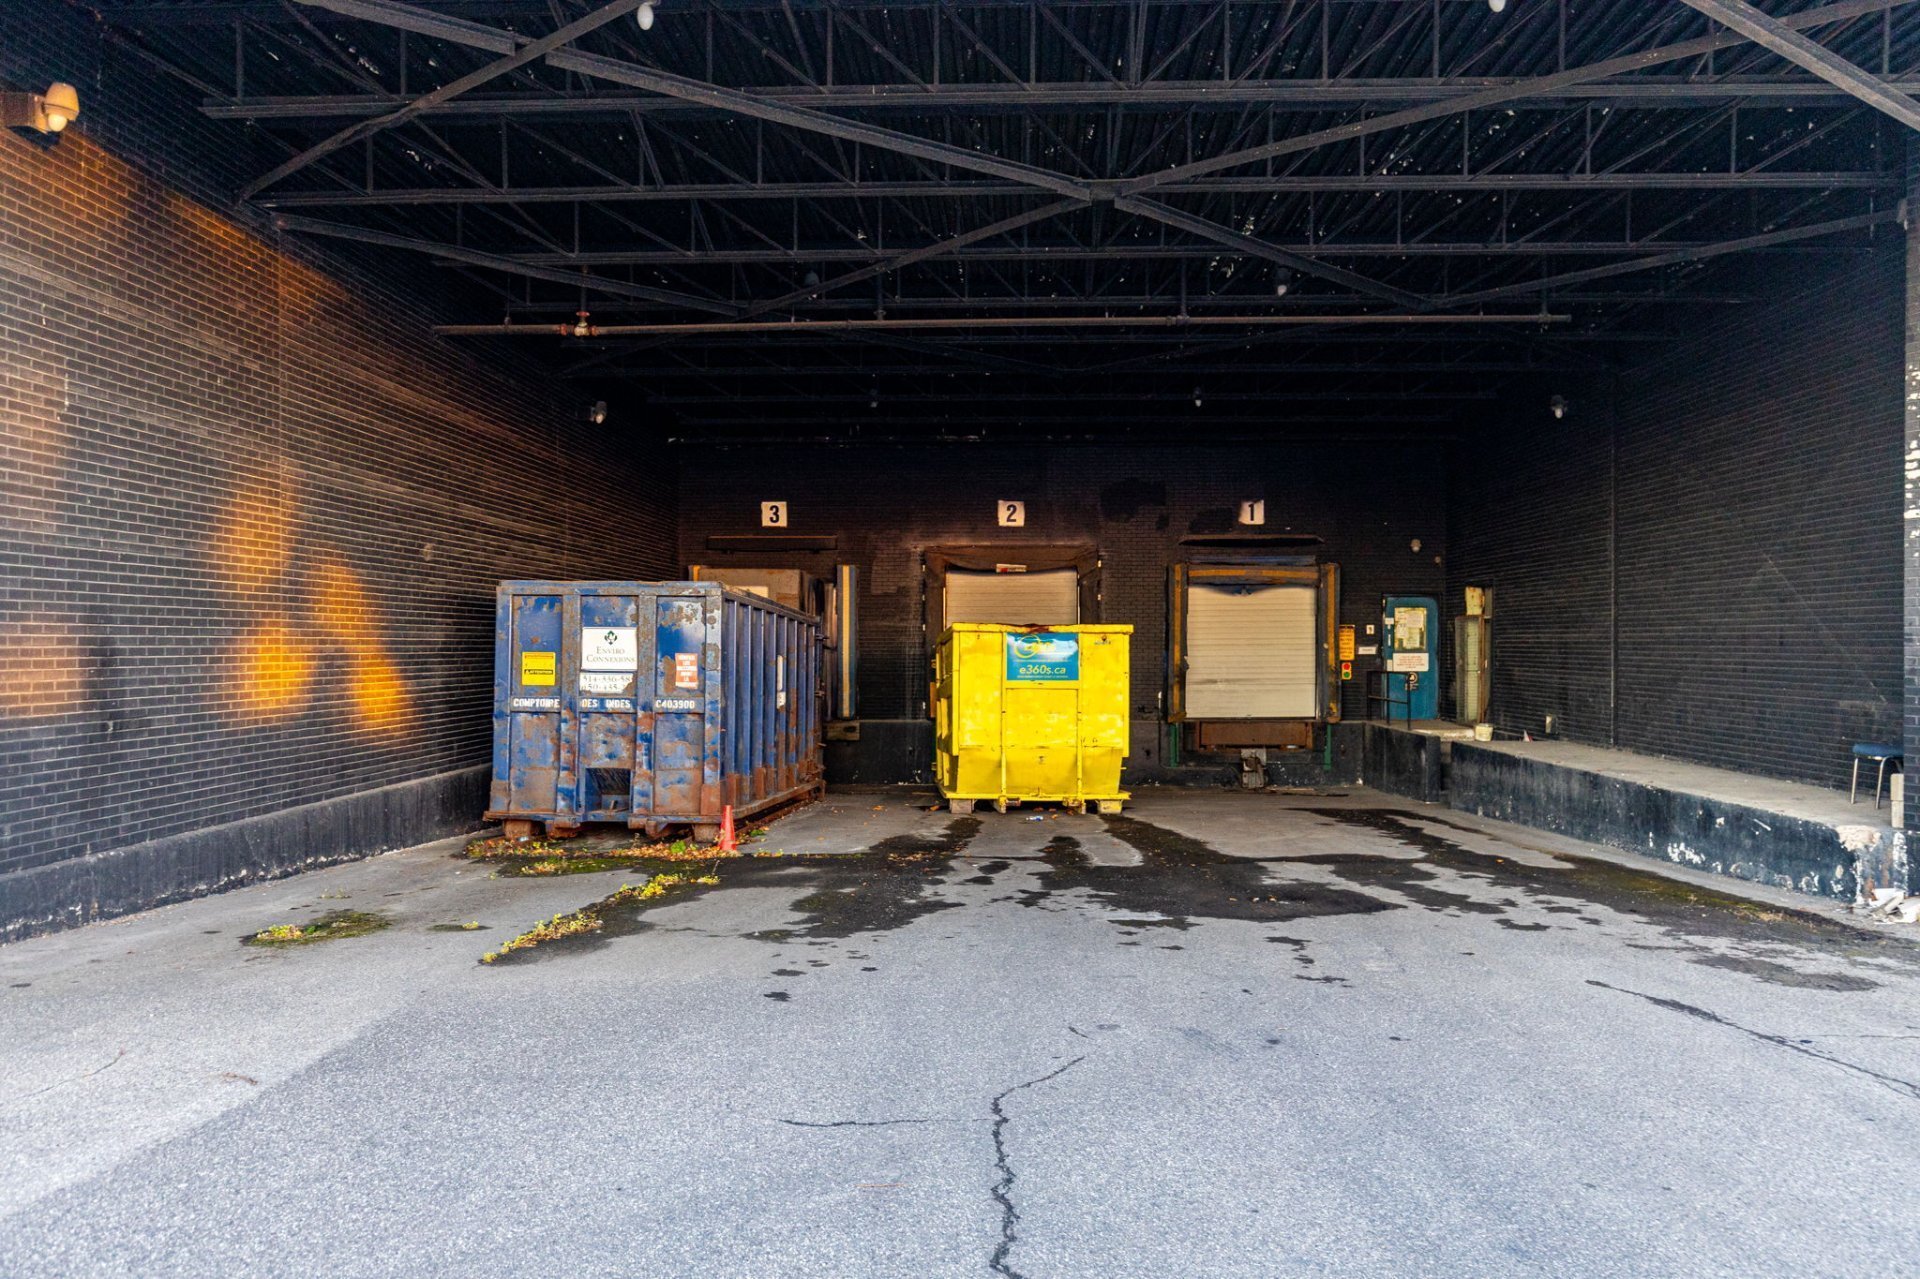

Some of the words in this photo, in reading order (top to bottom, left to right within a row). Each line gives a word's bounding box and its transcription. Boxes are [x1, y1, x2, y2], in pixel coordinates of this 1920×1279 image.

[769, 505, 780, 524] 3
[1006, 504, 1018, 523] 2
[1248, 503, 1255, 522] 1
[1019, 664, 1067, 675] e360s.ca
[513, 698, 561, 708] COMPTOIRE
[581, 699, 599, 708] DES
[605, 699, 632, 709] INDES
[655, 699, 696, 709] C403900
